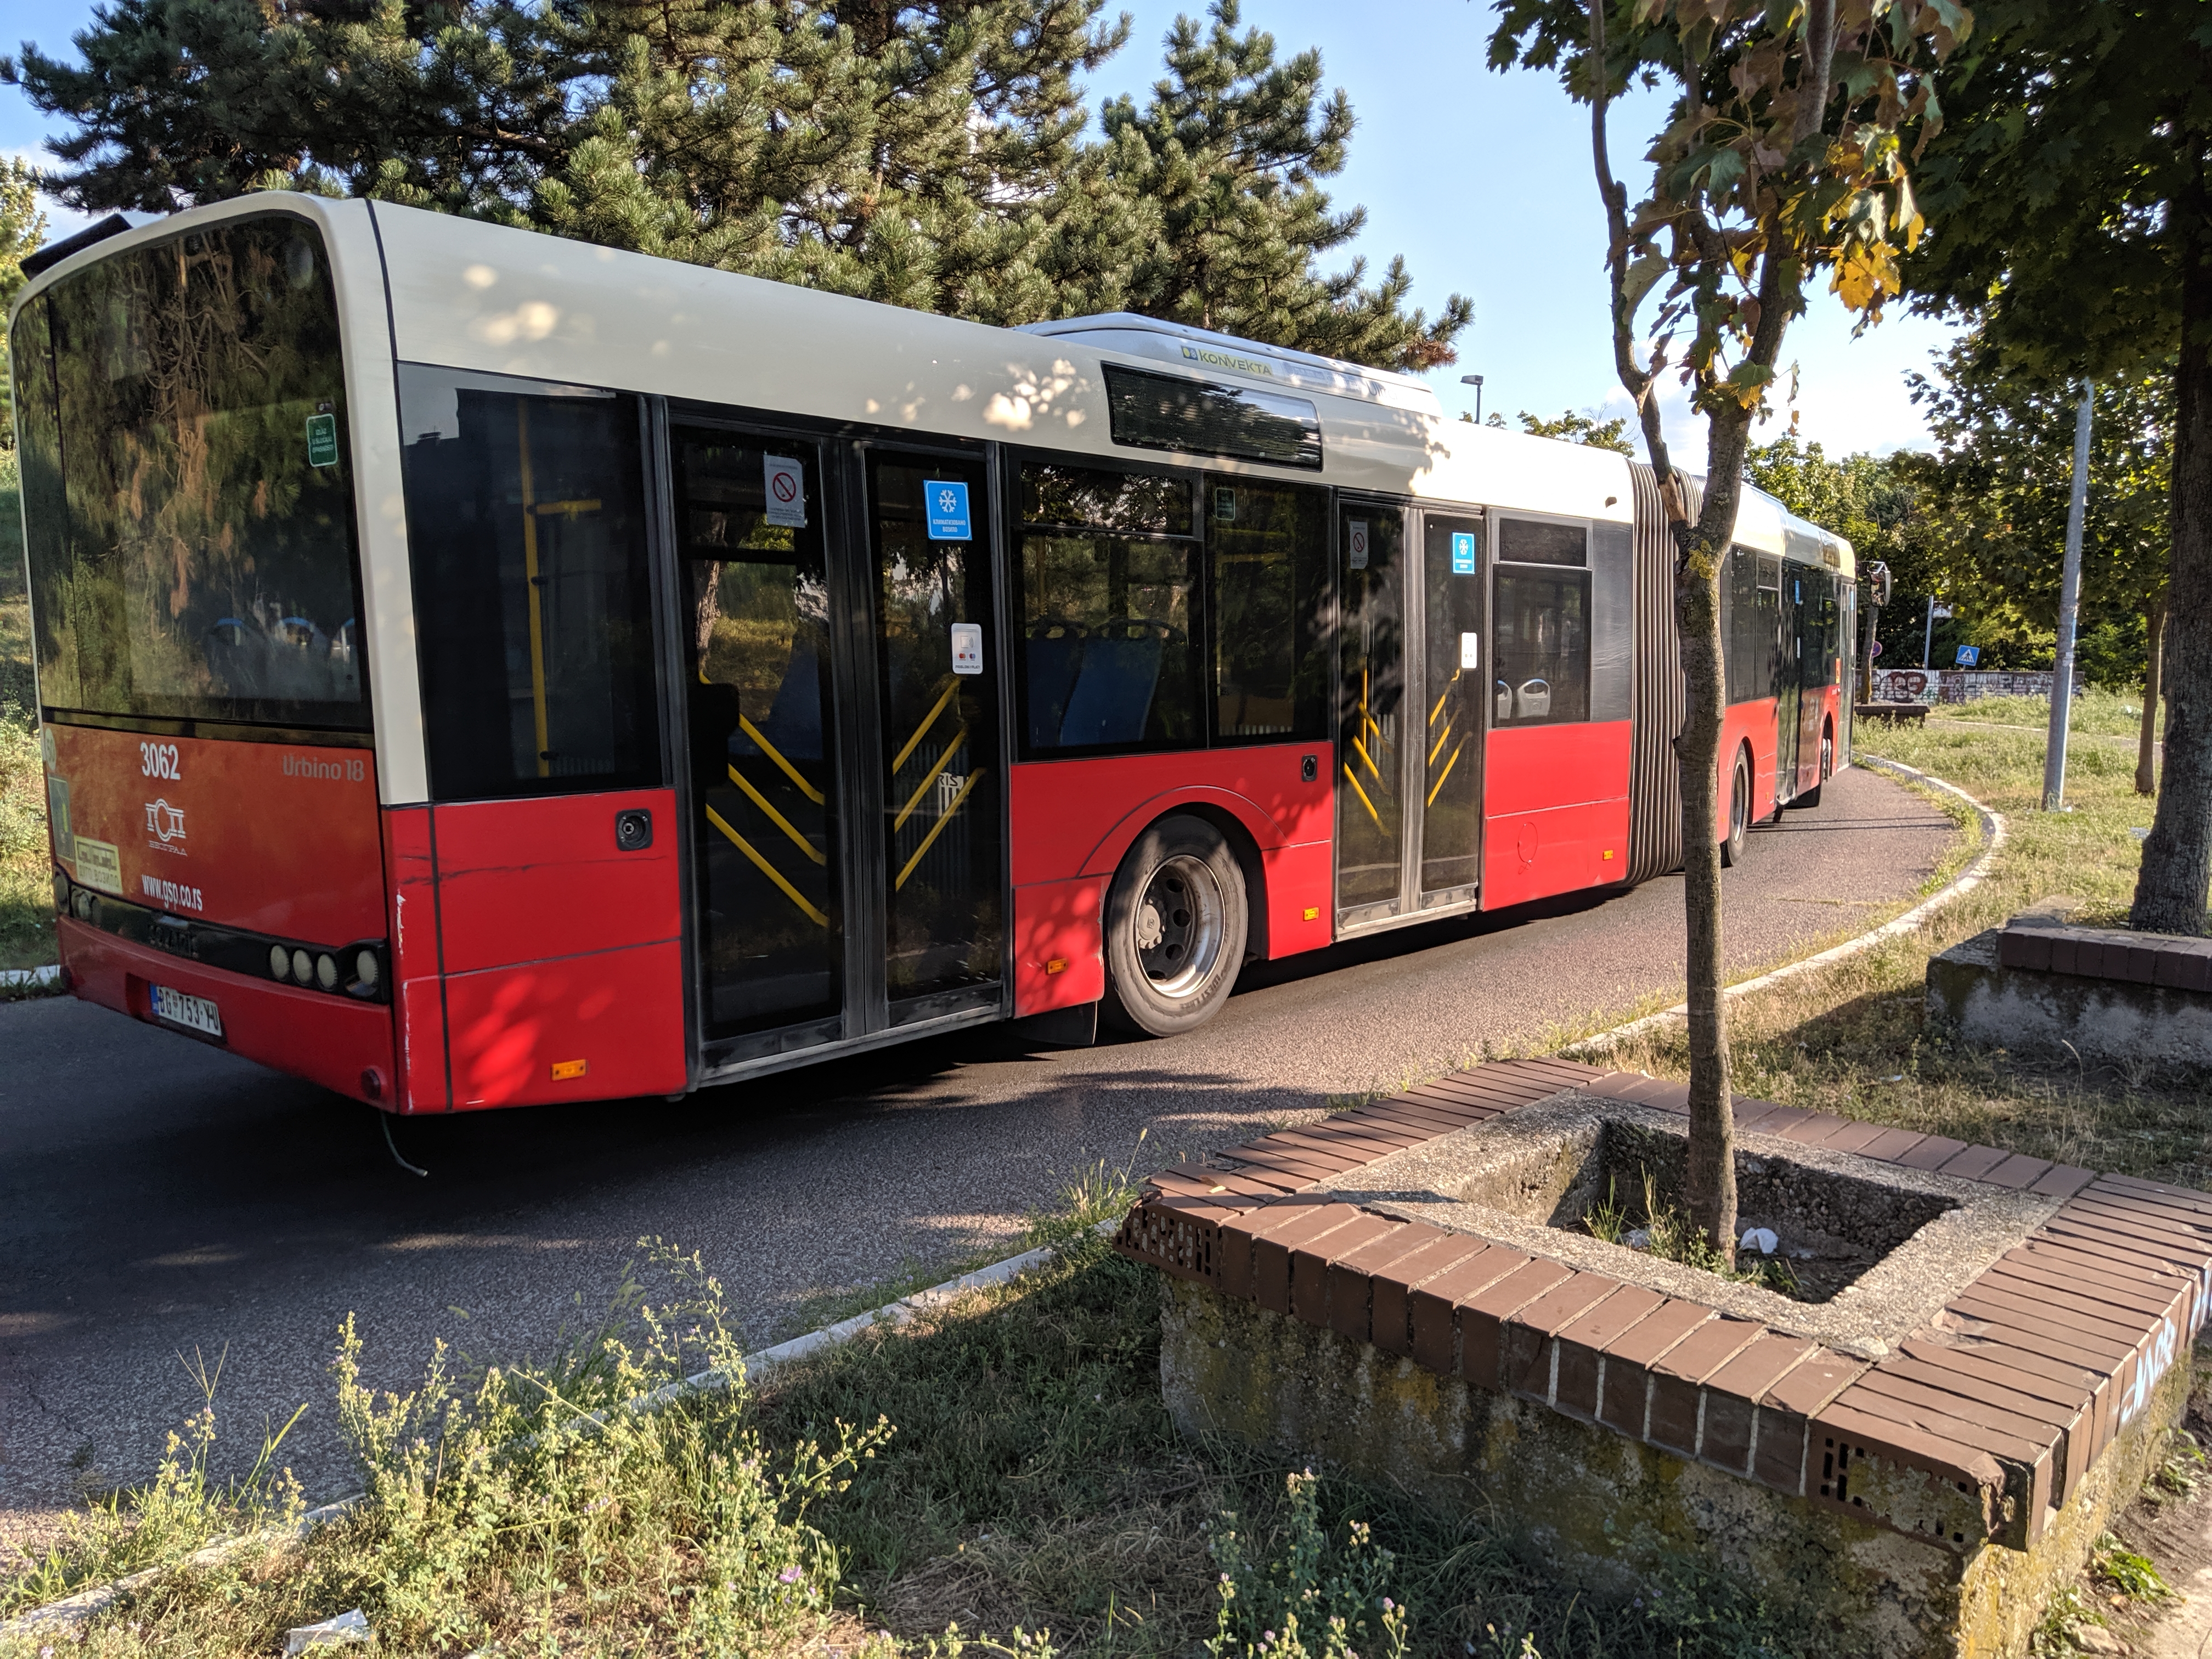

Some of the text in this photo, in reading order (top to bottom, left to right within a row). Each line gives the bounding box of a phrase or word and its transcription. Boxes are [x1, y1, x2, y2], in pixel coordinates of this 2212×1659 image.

[1198, 349, 1273, 375] KONVEKTA
[140, 742, 180, 780] 3062
[283, 754, 365, 782] Urbino 18
[142, 874, 202, 911] www.gsp.co.rs
